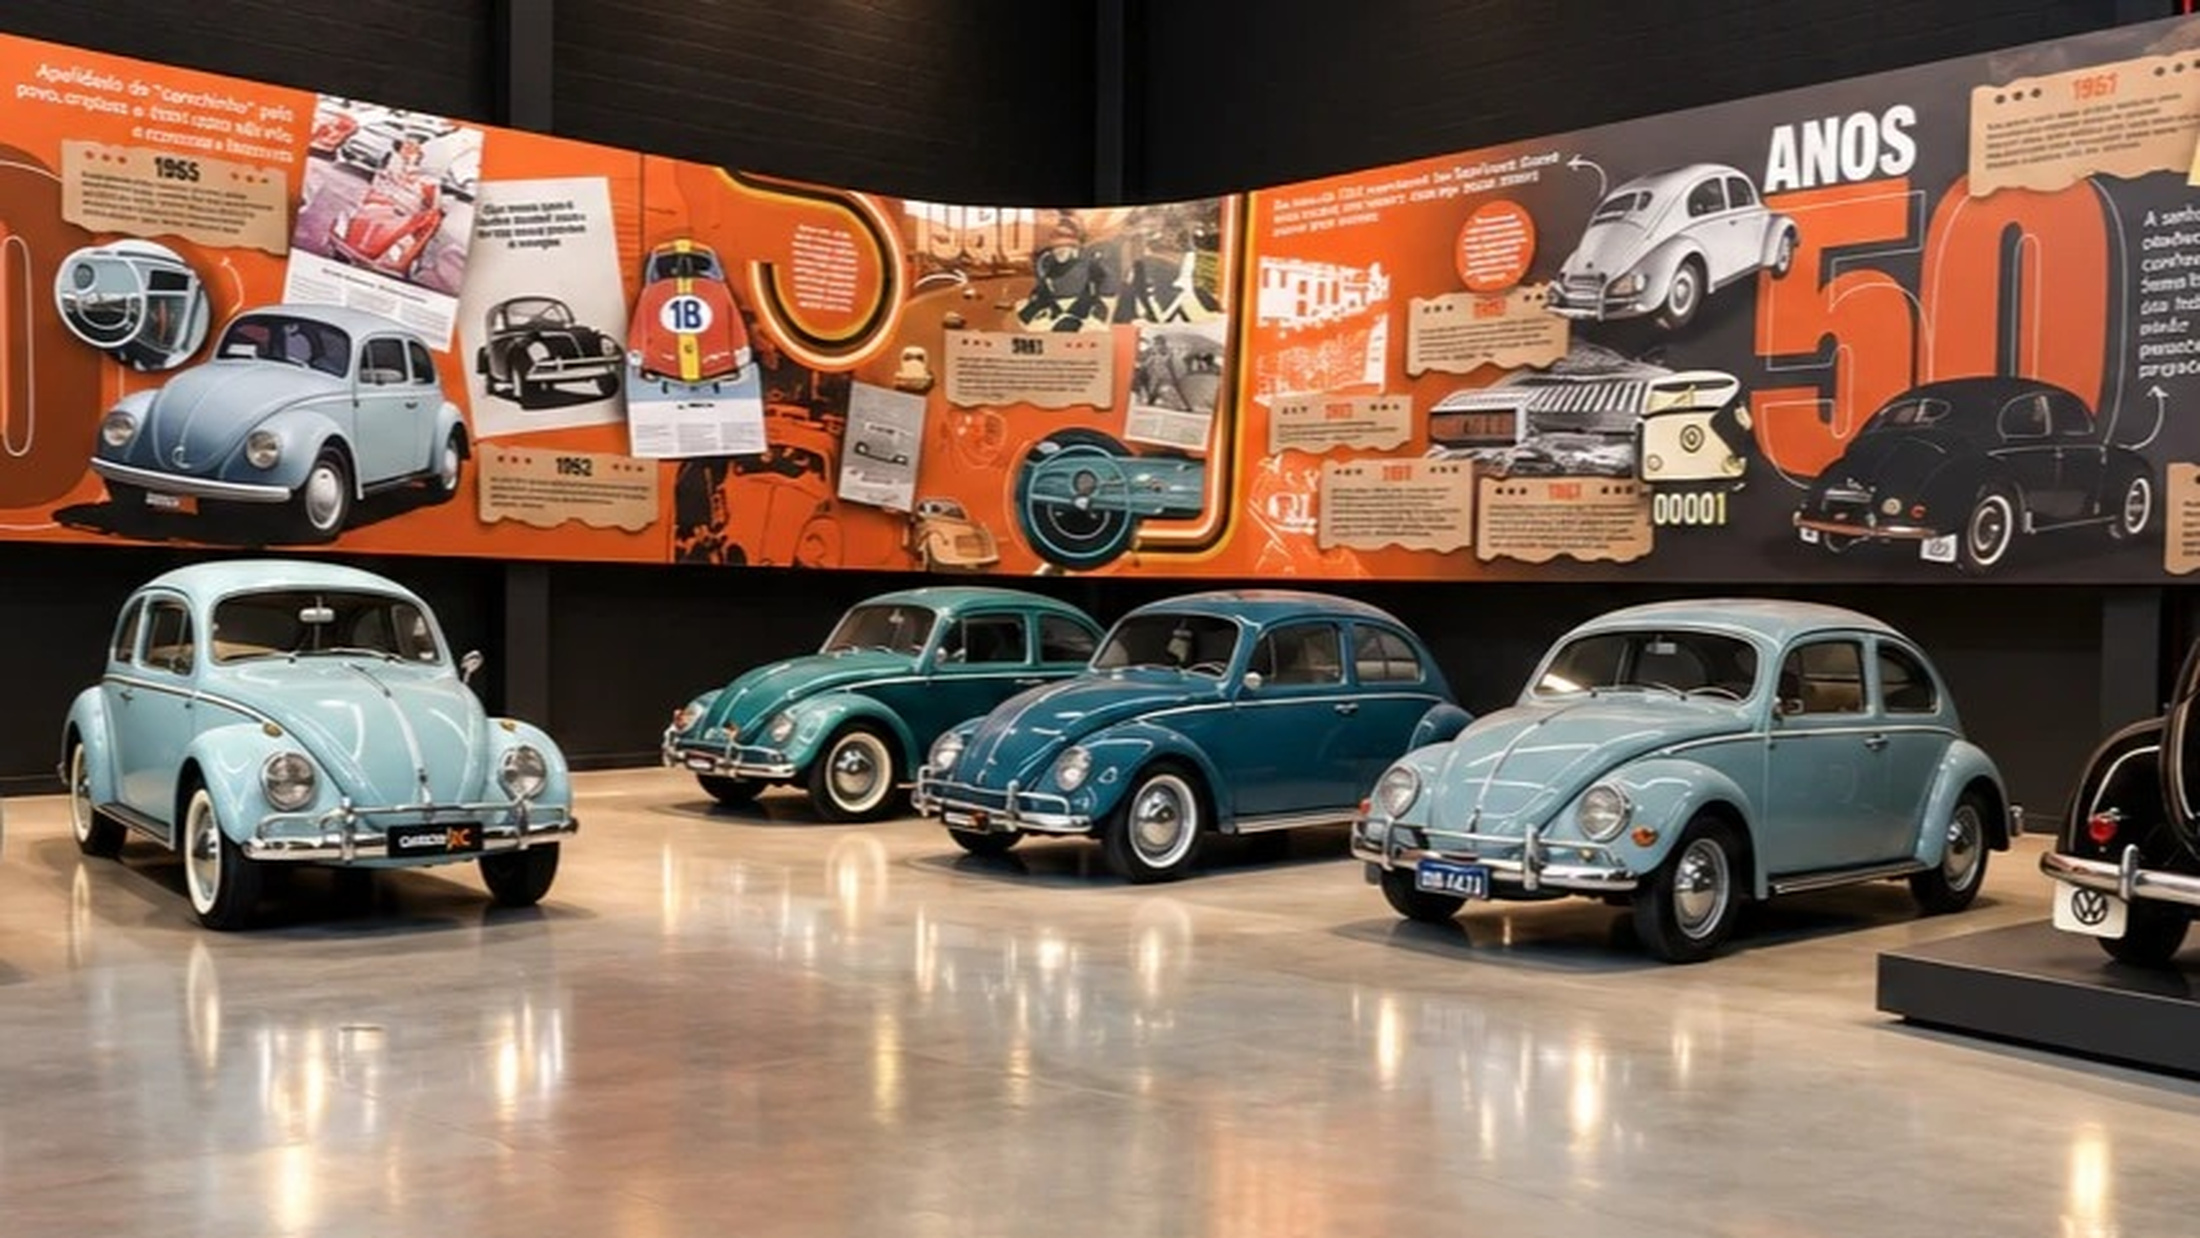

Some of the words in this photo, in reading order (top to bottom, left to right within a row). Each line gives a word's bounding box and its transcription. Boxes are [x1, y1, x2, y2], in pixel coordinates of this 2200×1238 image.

[1764, 104, 1917, 193] ANOS
[1750, 168, 2108, 477] 50
[1653, 491, 1726, 525] 00001
